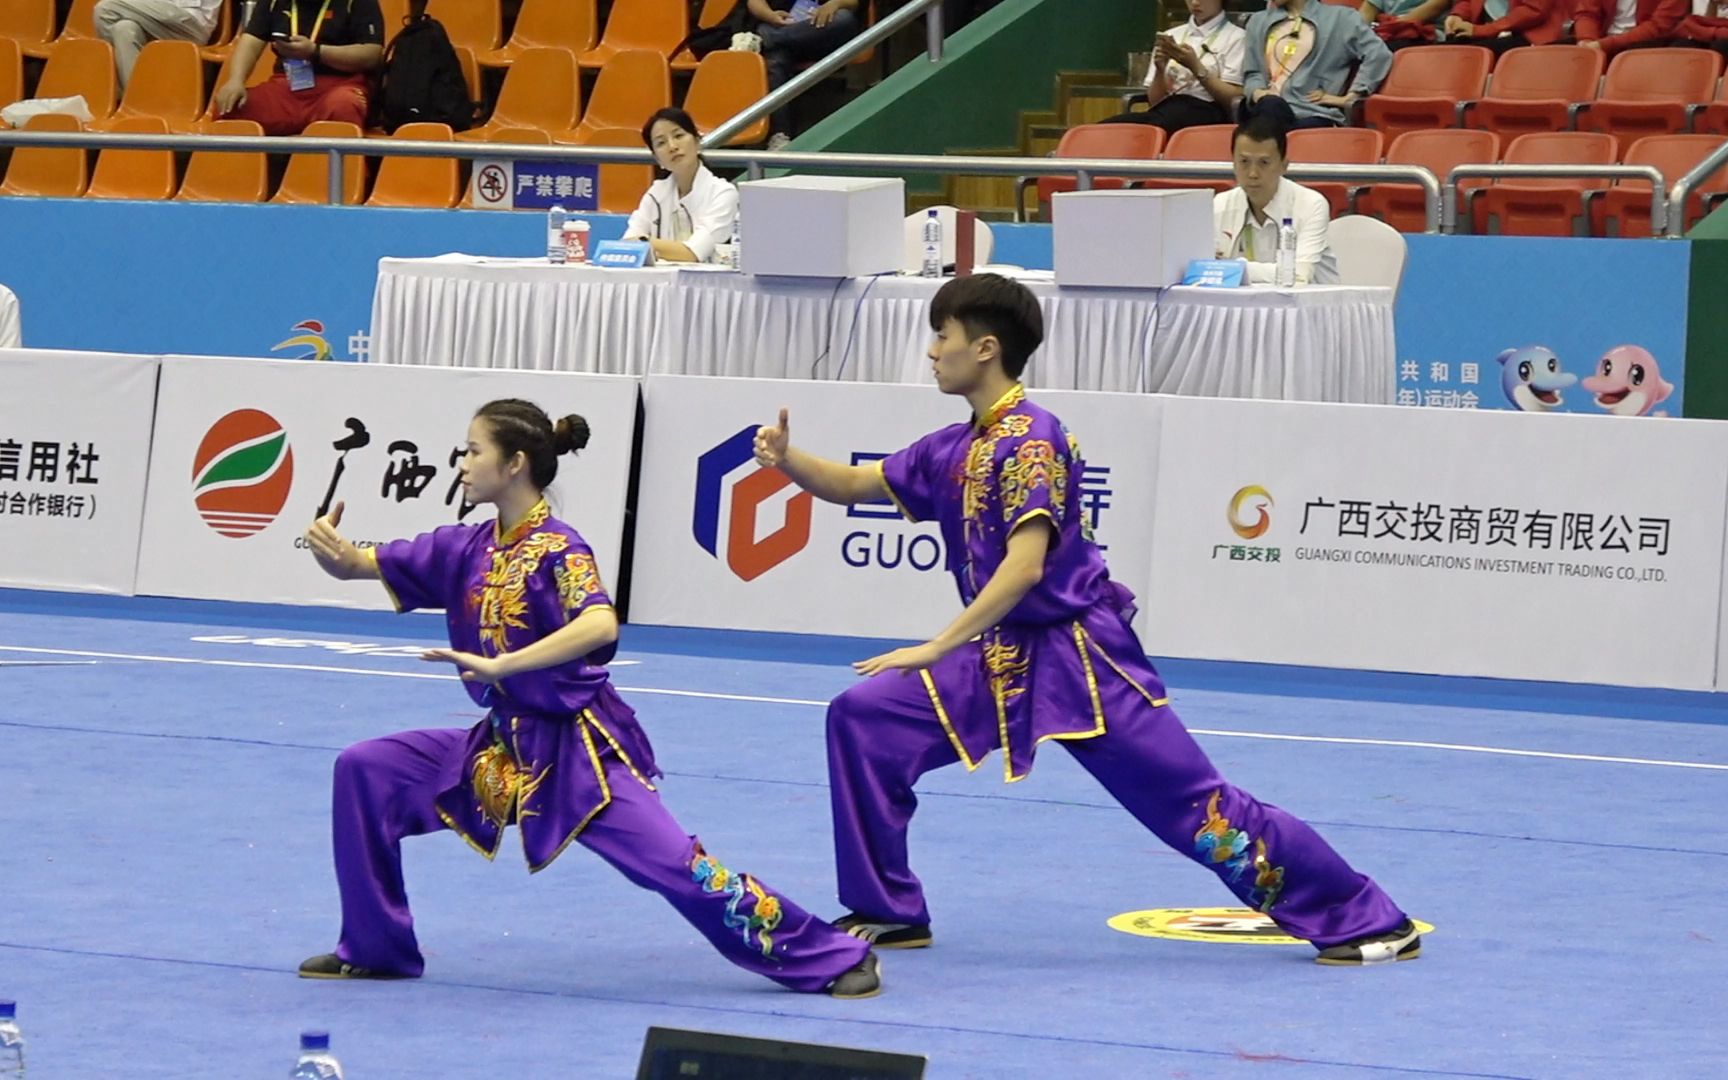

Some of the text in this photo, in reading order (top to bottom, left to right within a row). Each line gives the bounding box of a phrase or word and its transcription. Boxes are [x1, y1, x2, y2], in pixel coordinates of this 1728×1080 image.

[516, 174, 593, 198] 严禁攀爬
[1299, 496, 1671, 556] 广西交投商贸有限公司
[841, 531, 952, 571] GUO
[1212, 544, 1281, 563] 广西交投
[1295, 547, 1351, 563] GUANGXI
[1354, 550, 1472, 570] COMMUNICATIONS
[1474, 558, 1555, 576] INVESTMENT
[1558, 562, 1614, 580] TRADING
